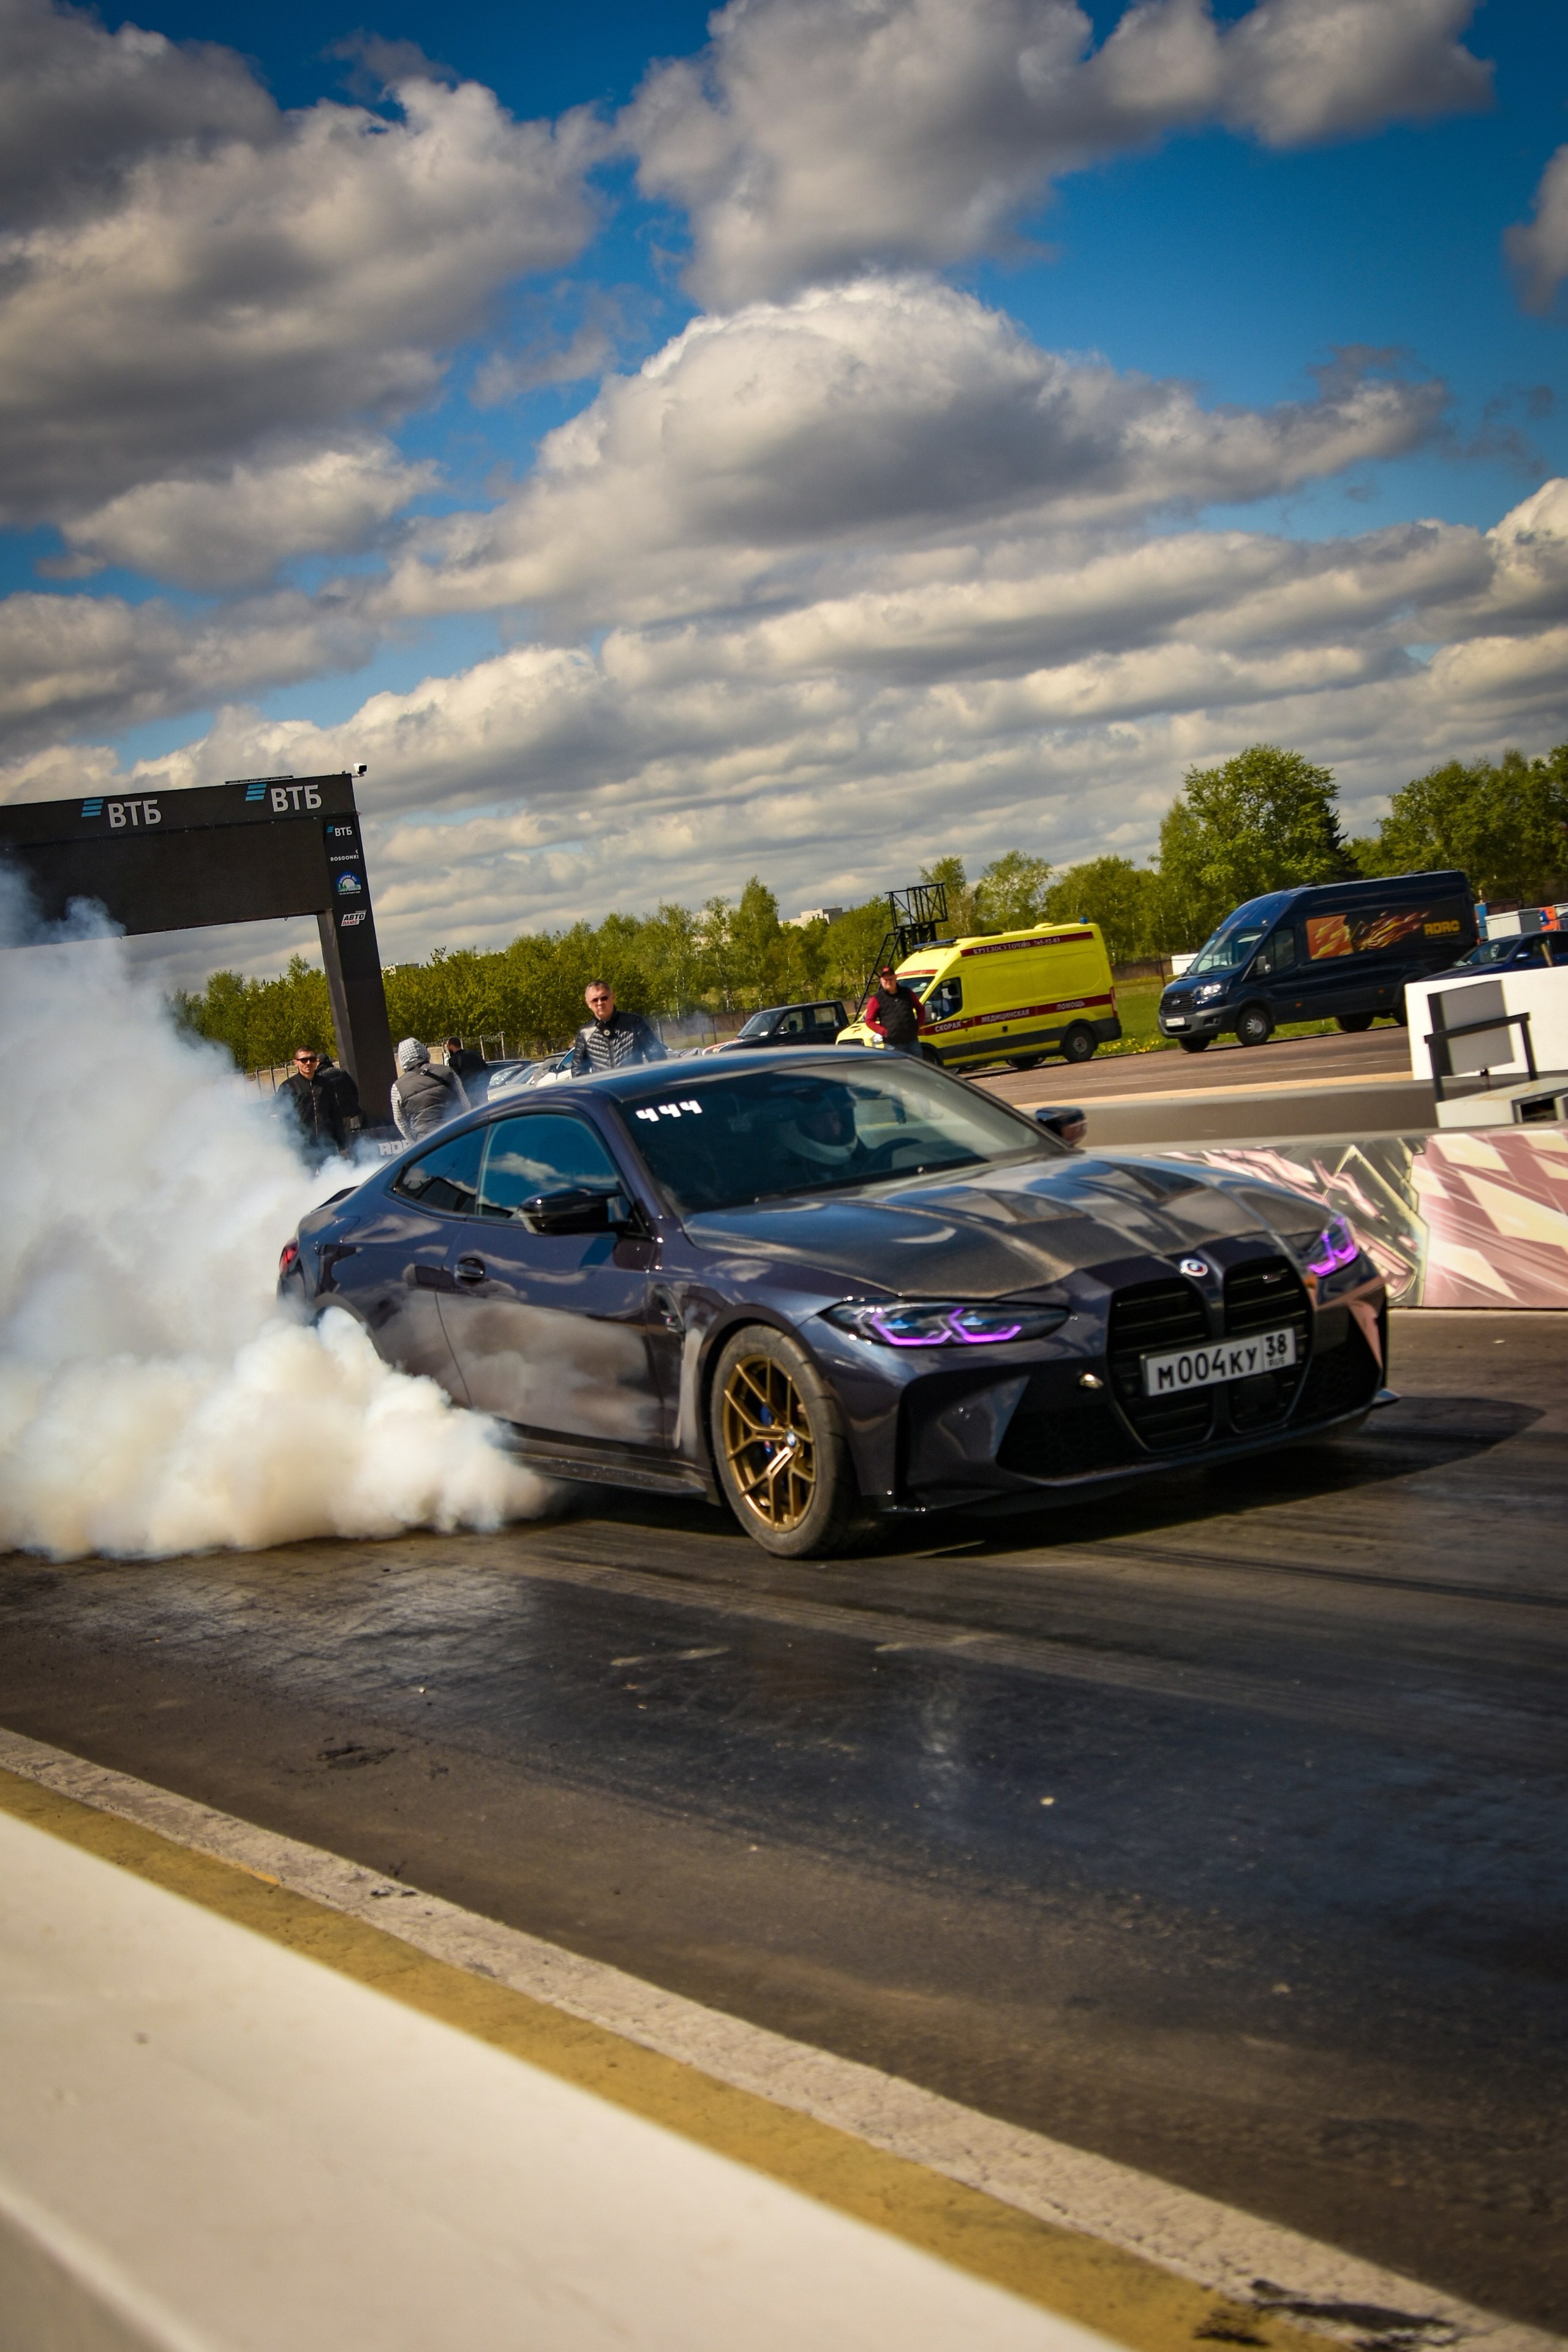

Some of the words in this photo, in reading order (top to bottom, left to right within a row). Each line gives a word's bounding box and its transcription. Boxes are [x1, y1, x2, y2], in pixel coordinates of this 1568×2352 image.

[271, 785, 322, 812] ВТБ
[108, 799, 162, 828] ВТБ
[334, 826, 352, 837] ВТБ
[1423, 920, 1460, 935] RDRC
[973, 941, 1030, 955] КРУГЛОСУТОЧНО
[935, 1021, 962, 1033] СКОРАЯ
[981, 1009, 1030, 1023] МЕДИЦИНСКАЯ
[1057, 1000, 1085, 1011] ПОМОЩЬ
[1265, 1333, 1287, 1357] 38
[1269, 1357, 1286, 1367] RUS
